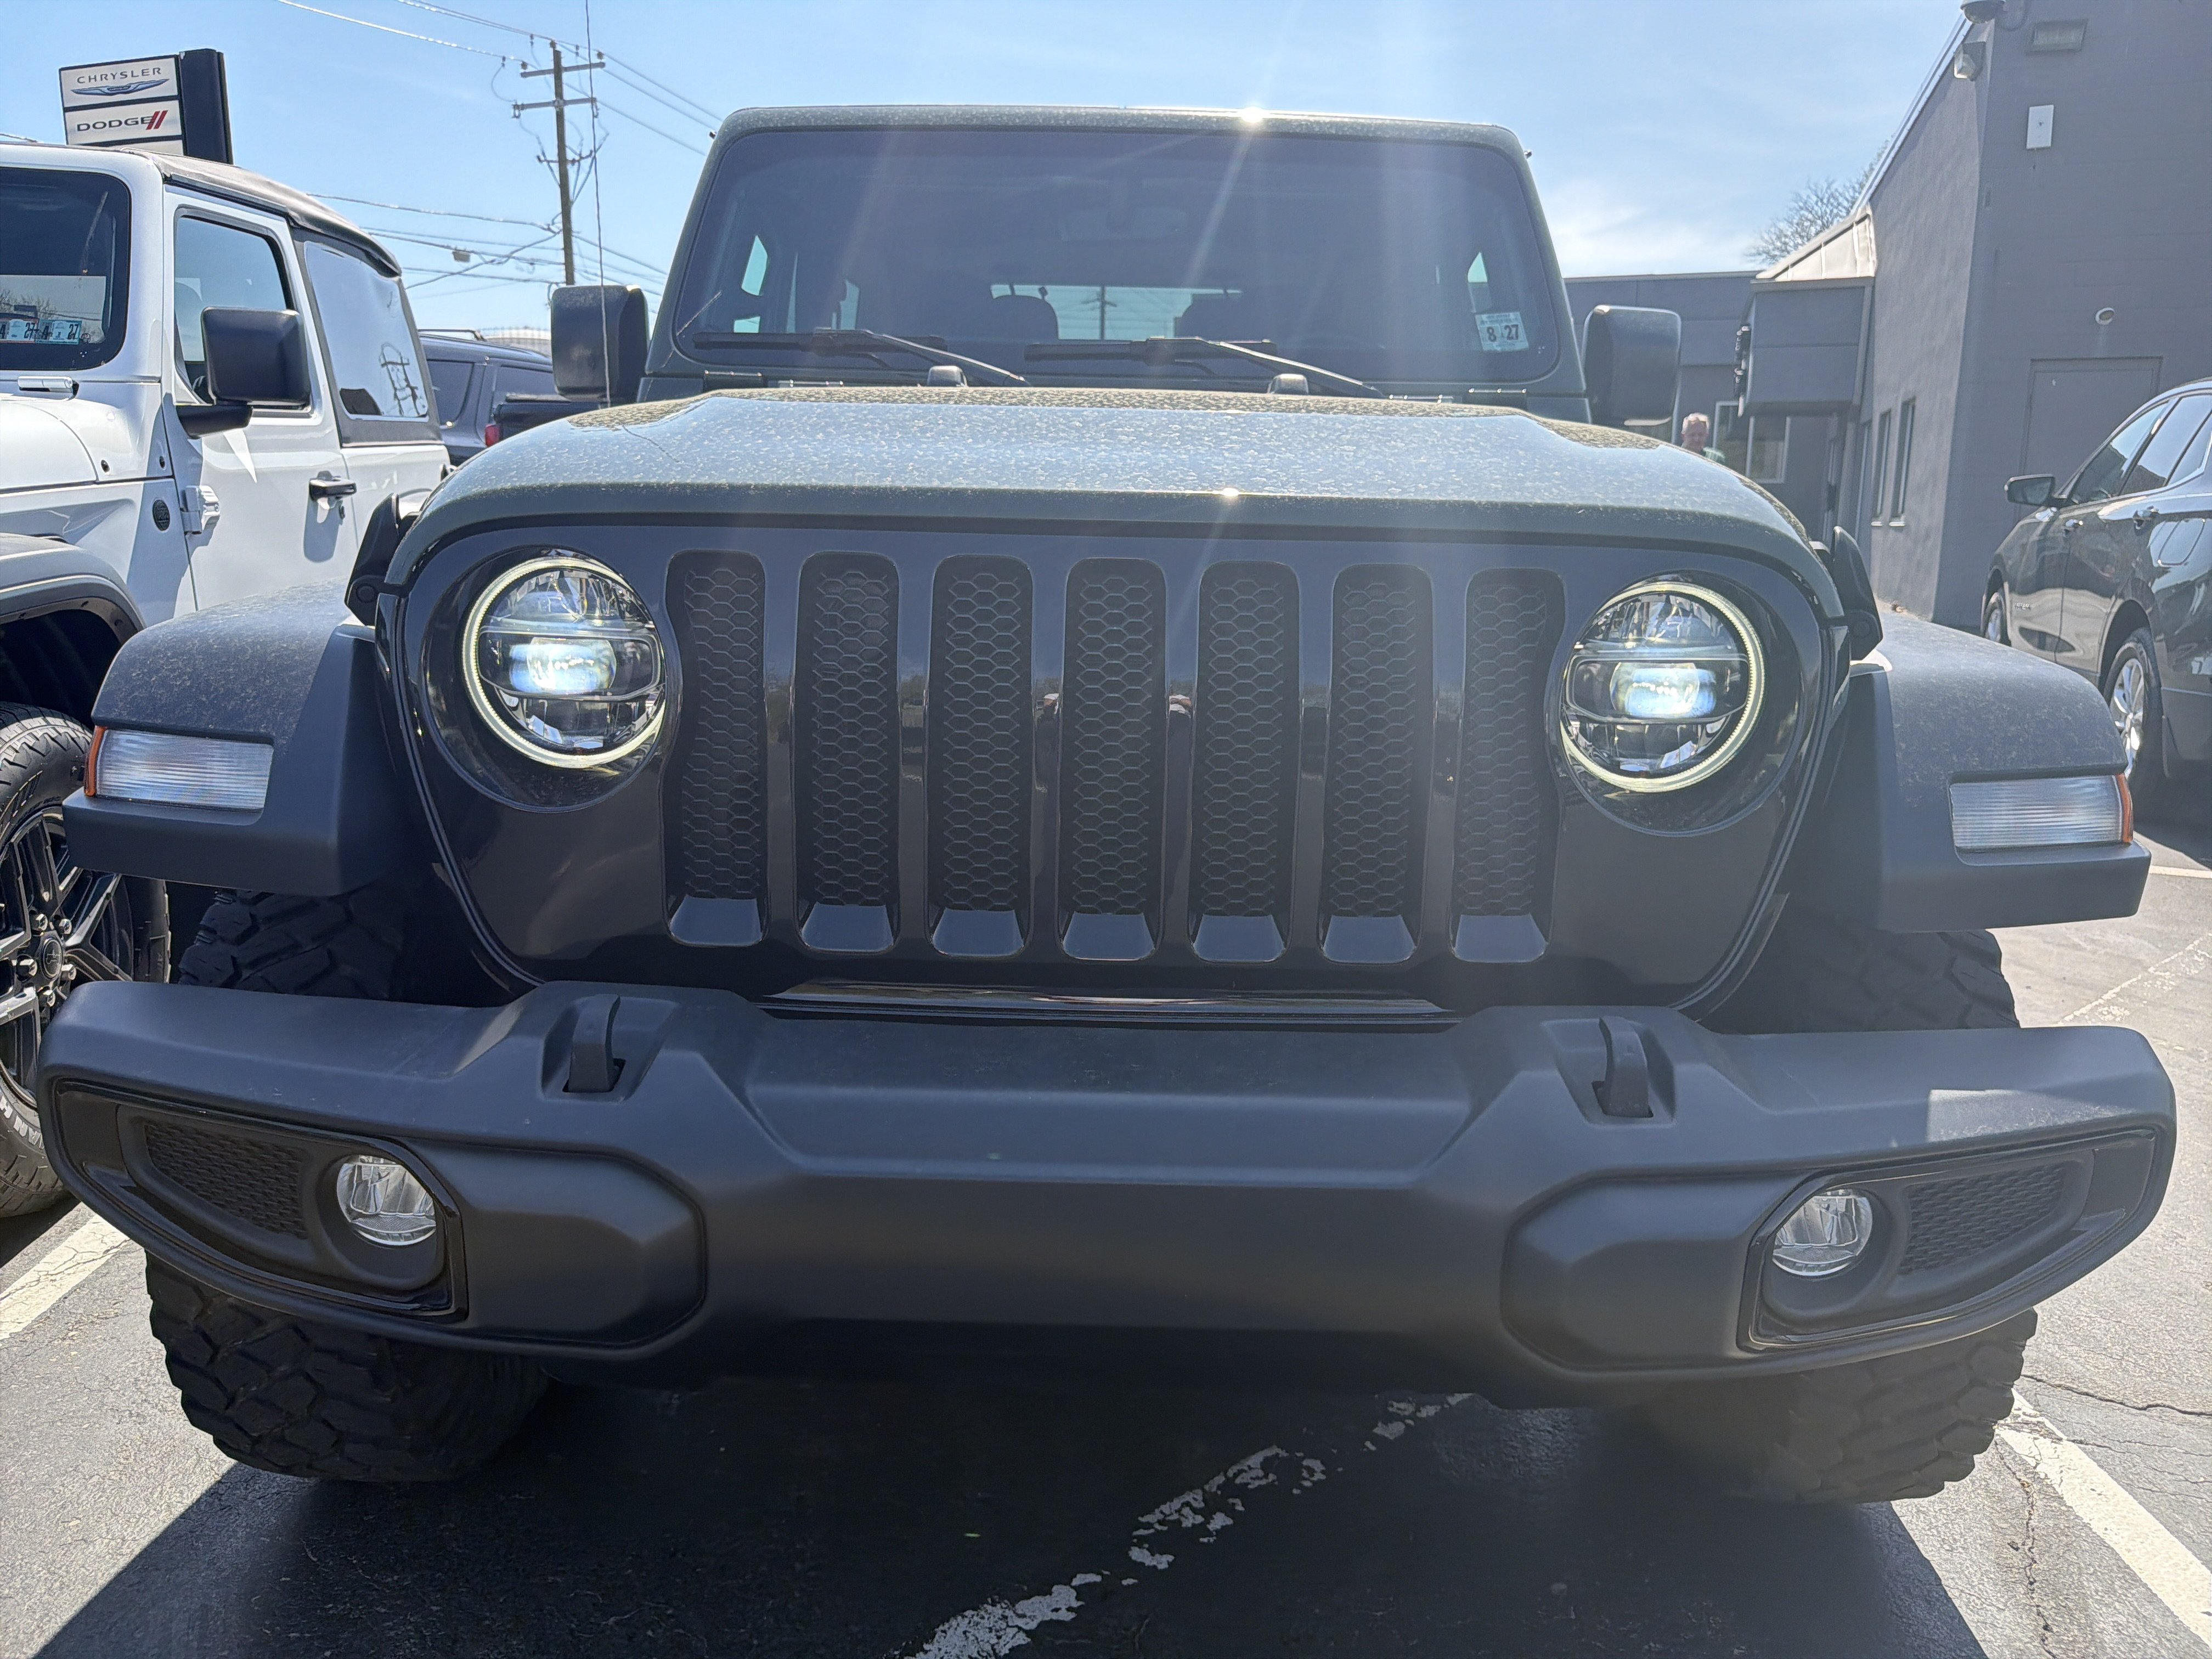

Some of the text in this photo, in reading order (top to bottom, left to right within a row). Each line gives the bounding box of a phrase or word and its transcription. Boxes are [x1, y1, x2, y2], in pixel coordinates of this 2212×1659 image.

[77, 67, 161, 84] CHRYSLER
[77, 116, 154, 132] DODGE
[24, 322, 36, 339] 27
[67, 324, 79, 340] 27
[1487, 324, 1519, 342] 8 27
